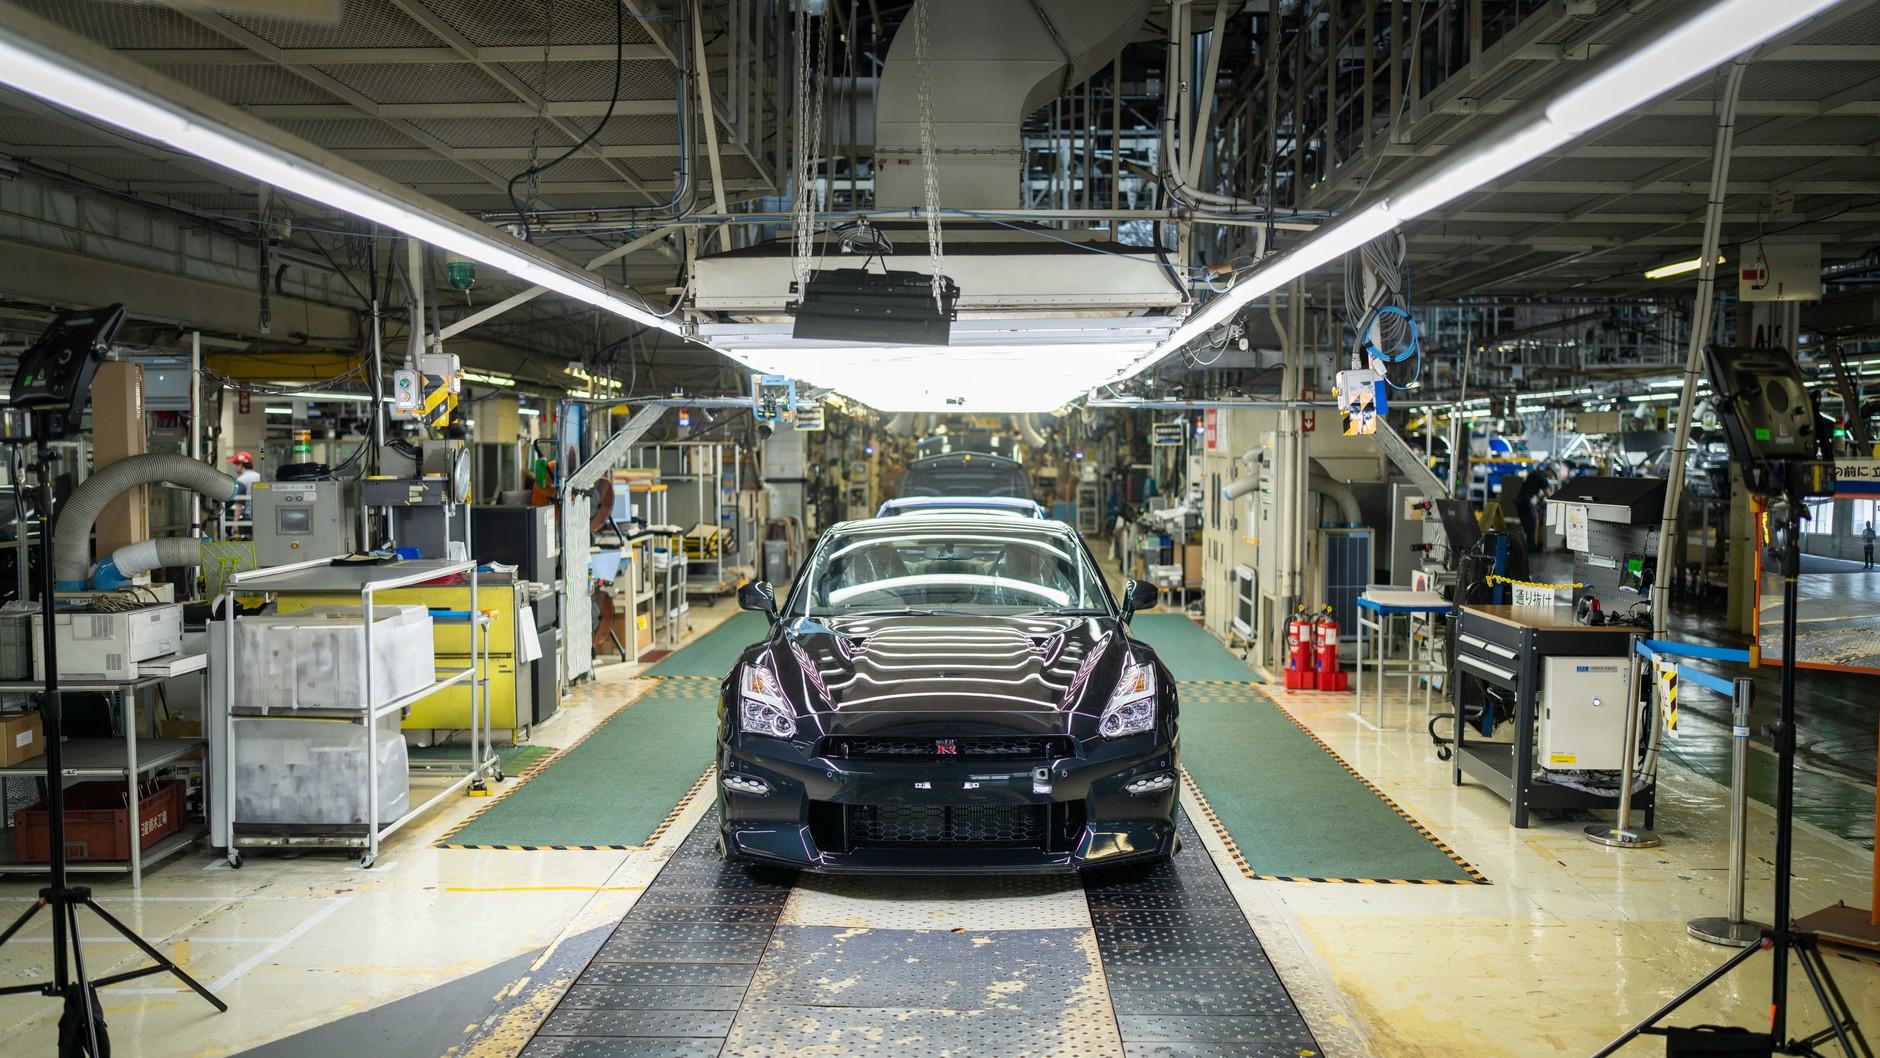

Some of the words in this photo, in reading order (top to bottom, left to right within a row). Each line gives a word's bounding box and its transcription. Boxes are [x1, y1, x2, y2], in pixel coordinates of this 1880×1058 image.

[1835, 466, 1869, 478] の前に
[1516, 589, 1552, 606] 通り抜け
